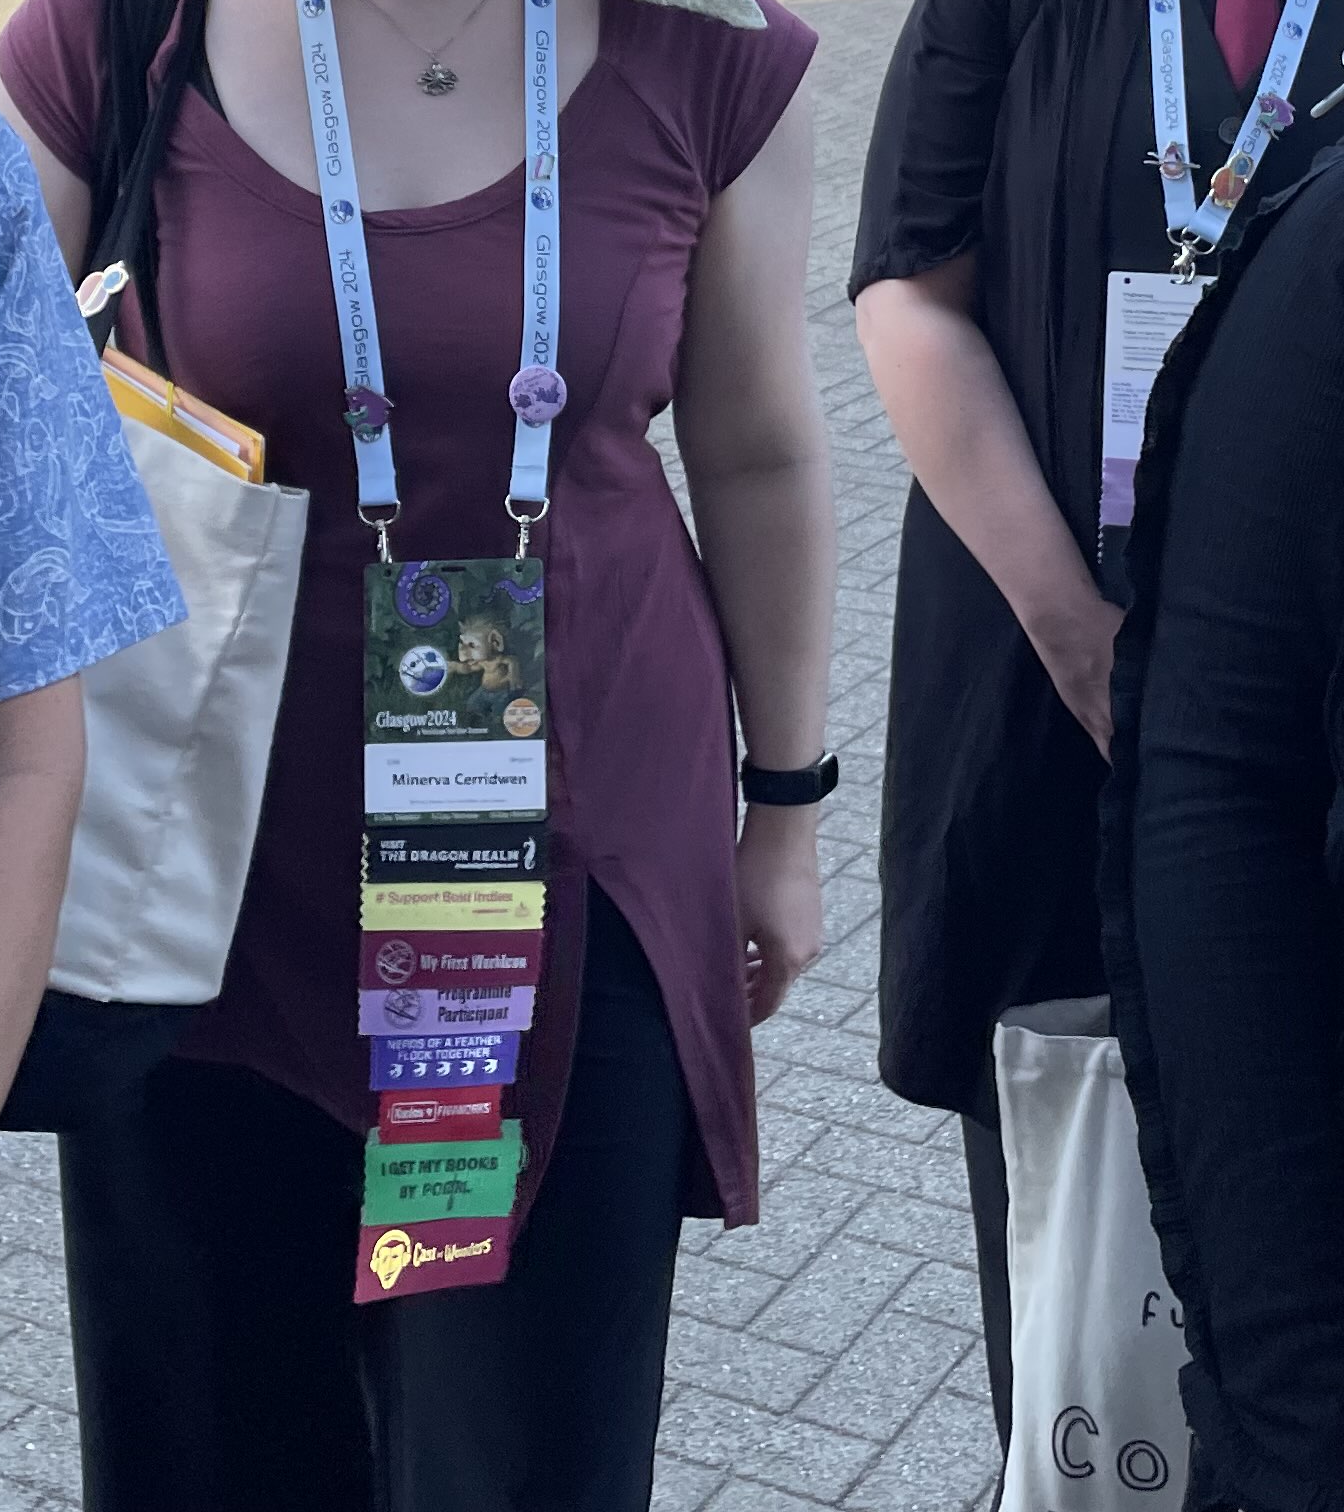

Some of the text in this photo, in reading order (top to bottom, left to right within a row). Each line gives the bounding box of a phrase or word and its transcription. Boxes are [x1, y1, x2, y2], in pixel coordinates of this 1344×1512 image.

[532, 30, 550, 114] Glasgow
[311, 42, 342, 176] Glasgow 2024
[338, 248, 358, 293] 2024
[533, 235, 550, 325] Glasgow
[376, 710, 456, 732] Glasgow2024
[392, 772, 527, 786] Minerva Cerridwen
[380, 851, 520, 862] THE DRAGON REALM
[388, 891, 439, 905] Support
[420, 954, 528, 971] My First Worldcon
[438, 1006, 509, 1025] Participant
[435, 1048, 490, 1060] TOGETHER
[381, 1156, 498, 1176] I GET MY BOOKS
[400, 1185, 417, 1199] BY
[413, 1242, 437, 1268] Cast
[444, 1238, 492, 1262] Wonders
